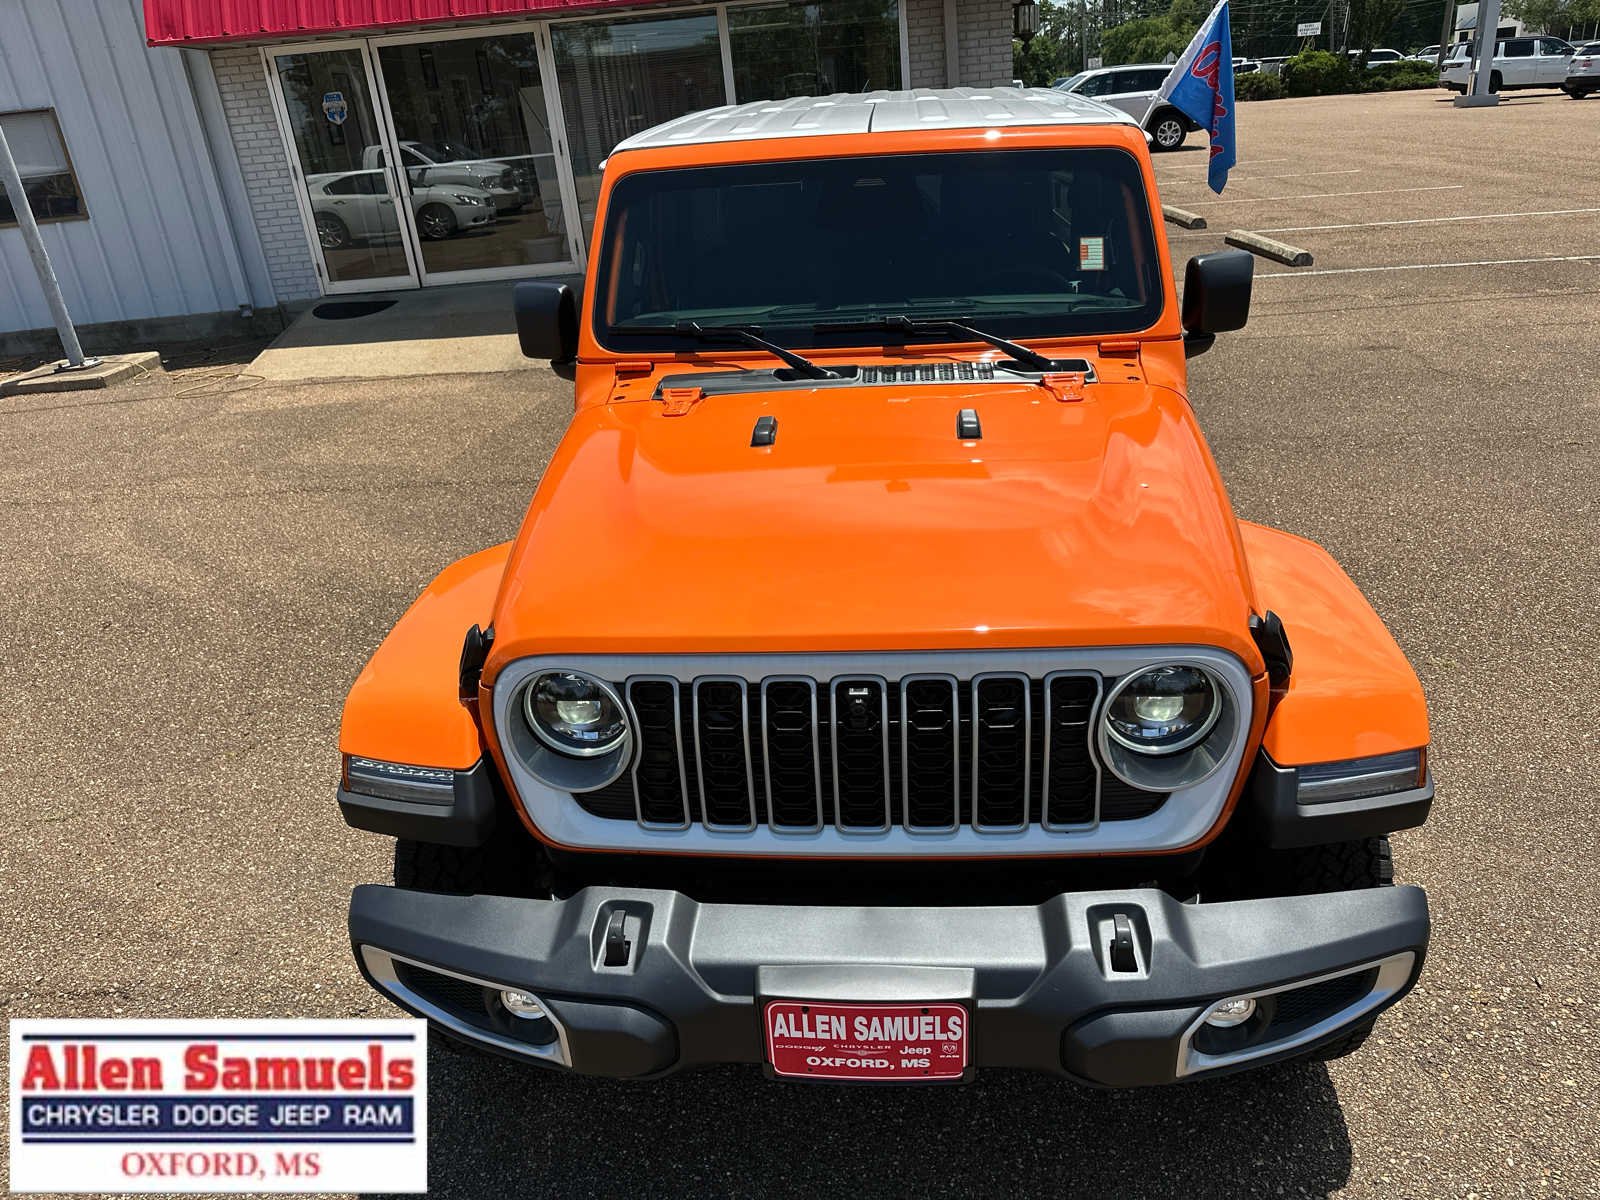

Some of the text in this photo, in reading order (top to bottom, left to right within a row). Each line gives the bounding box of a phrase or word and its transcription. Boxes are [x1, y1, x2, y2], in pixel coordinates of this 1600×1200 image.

[773, 1013, 963, 1042] ALLEN SAMUELS
[900, 1045, 932, 1055] Jeep
[806, 1056, 931, 1070] OXFORD, MS
